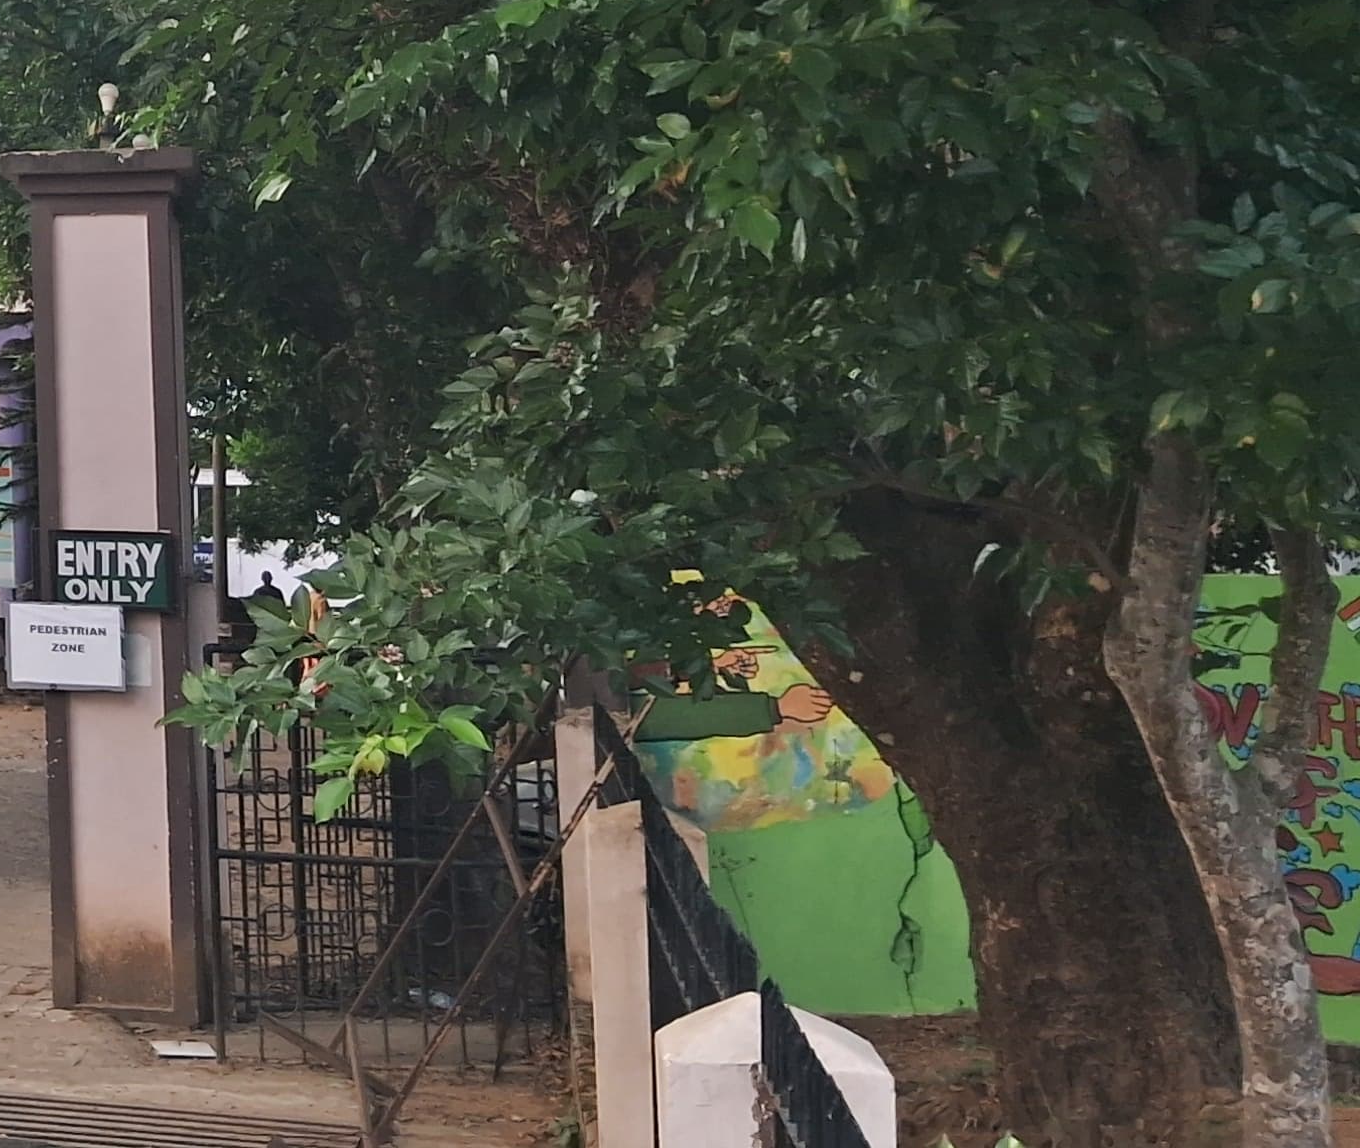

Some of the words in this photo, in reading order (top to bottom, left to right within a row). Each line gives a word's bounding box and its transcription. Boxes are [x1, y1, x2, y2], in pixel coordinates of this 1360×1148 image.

[56, 539, 163, 579] ENTRY
[64, 578, 155, 603] ONLY
[29, 624, 107, 637] PEDESTRIAN
[51, 642, 86, 653] ZONE
